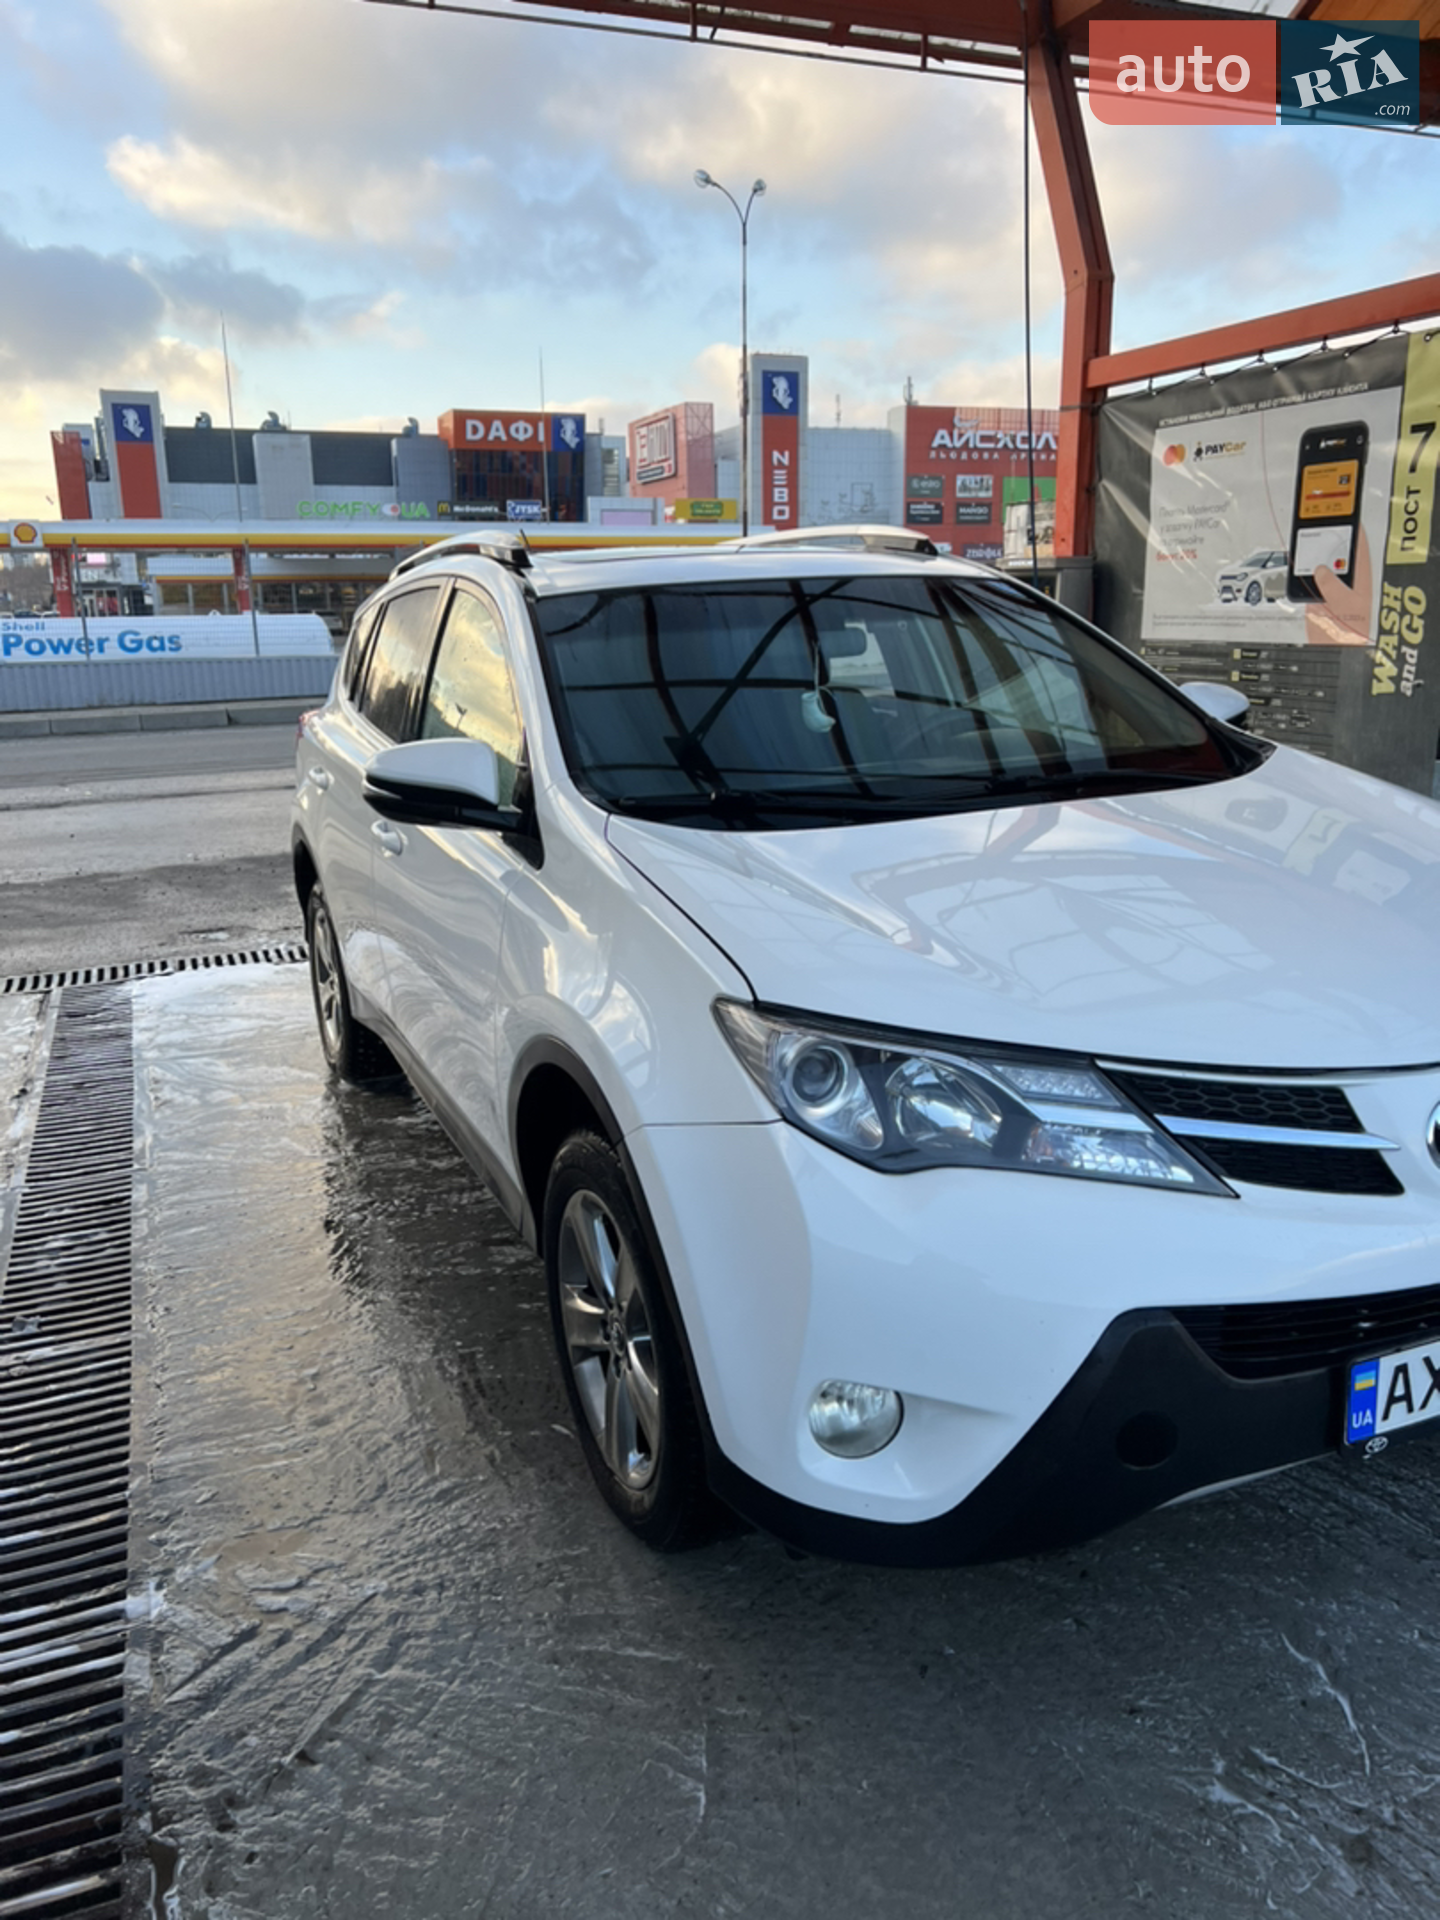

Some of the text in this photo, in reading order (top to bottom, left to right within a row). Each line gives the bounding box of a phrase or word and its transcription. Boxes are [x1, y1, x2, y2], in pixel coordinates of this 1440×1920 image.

[929, 450, 1000, 460] ЛЬОДОВА
[1204, 441, 1247, 455] PAYCar
[1409, 421, 1437, 474] 7
[296, 501, 430, 519] COMFY UA
[1400, 485, 1421, 552] ПОСТ
[1, 622, 46, 631] Shell
[1372, 581, 1403, 696] WASH
[2, 630, 183, 657] Power Gas
[1400, 585, 1427, 697] and GO
[1381, 1355, 1440, 1422] AX
[1352, 1409, 1374, 1429] UA
